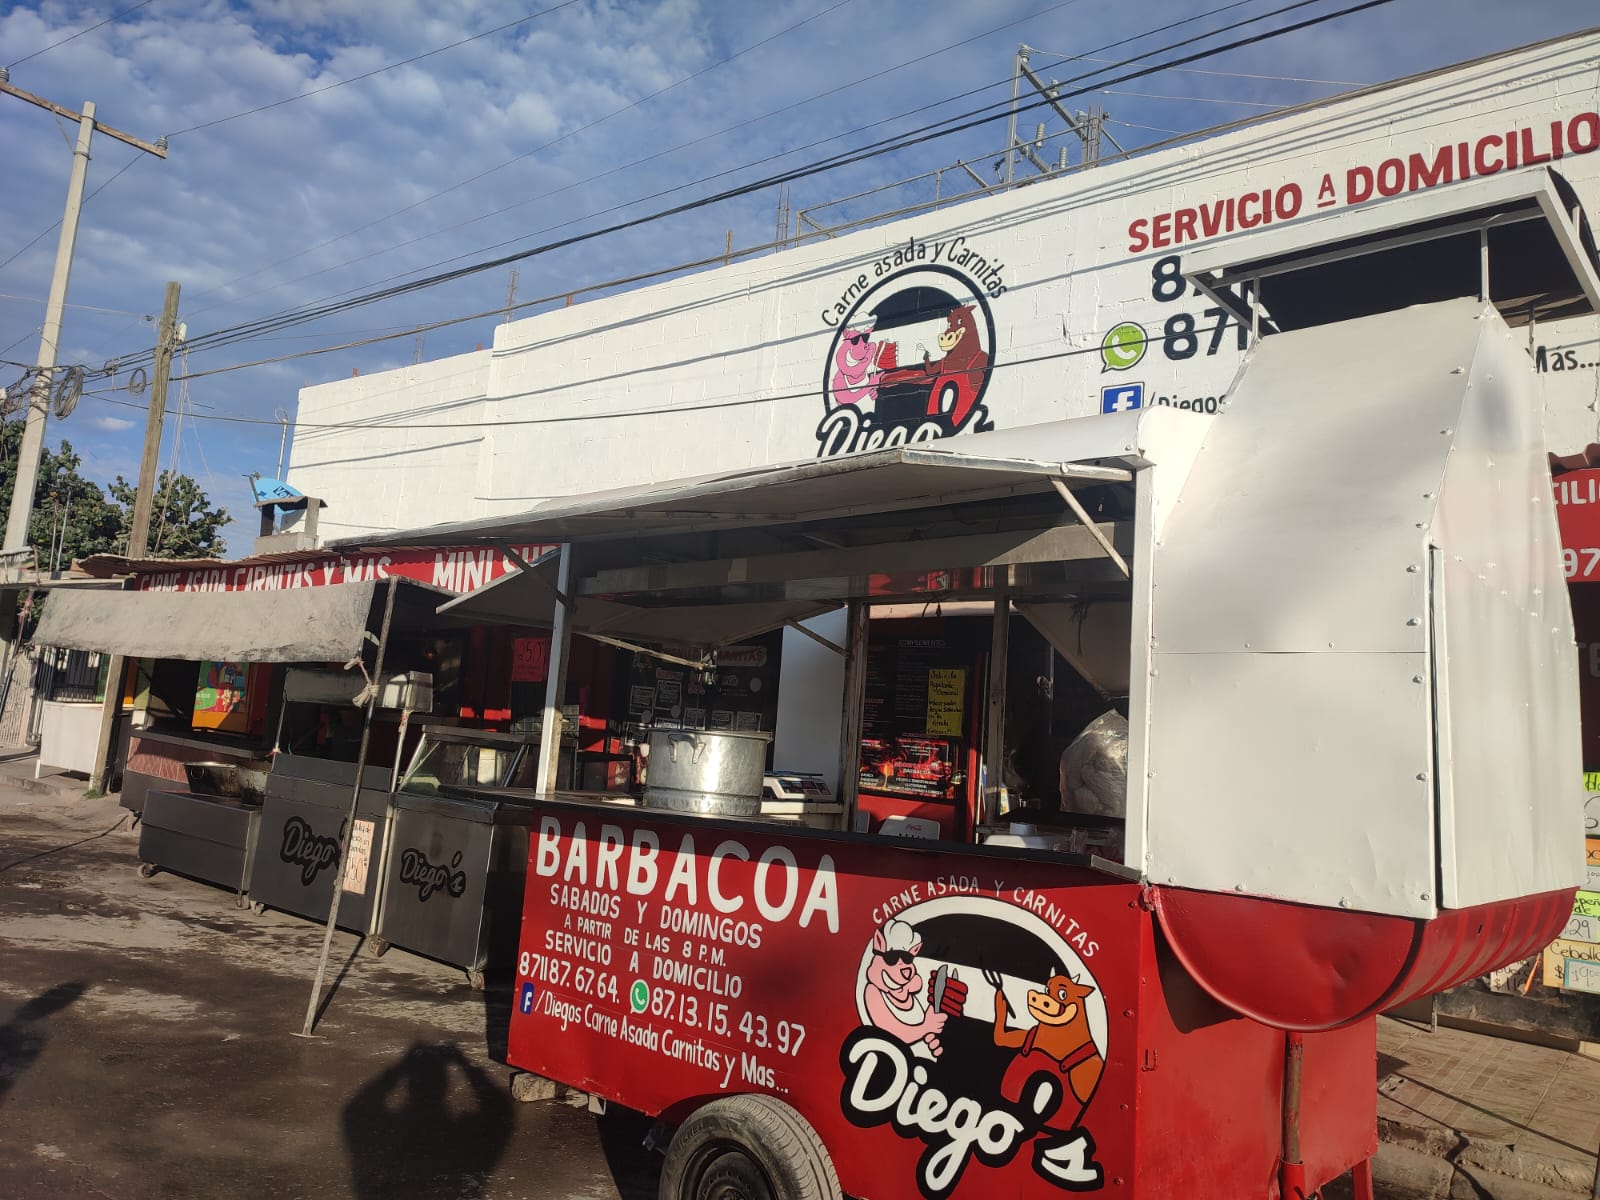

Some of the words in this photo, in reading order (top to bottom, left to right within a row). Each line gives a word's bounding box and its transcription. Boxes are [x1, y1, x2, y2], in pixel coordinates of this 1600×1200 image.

[1128, 182, 1302, 254] SERVICIO
[1317, 173, 1337, 208] A
[1347, 112, 1600, 205] DOMICILIO
[821, 272, 870, 327] Carne
[873, 236, 926, 277] asada
[930, 242, 947, 263] y
[947, 237, 1008, 299] Carnitas
[185, 569, 228, 592] ASADA
[233, 562, 317, 592] CARNITAS
[323, 561, 336, 586] Y
[343, 556, 392, 583] MAS
[432, 549, 494, 593] MINI
[401, 850, 466, 900] Diego's
[536, 816, 840, 934] BARBACOA
[550, 883, 621, 920] SABADOS
[637, 900, 648, 924] Y
[660, 905, 763, 949] DOMINGOS
[564, 913, 572, 930] A
[577, 914, 612, 940] PARTIR
[624, 927, 639, 946] DE
[645, 931, 671, 954] LAS
[682, 940, 692, 957] 8
[699, 943, 727, 967] P.M.
[873, 885, 921, 925] CARNE
[927, 875, 979, 897] ASADA
[994, 881, 1004, 897] Y
[1013, 887, 1100, 957] CARNITAS
[1565, 918, 1591, 939] 29
[545, 930, 612, 966] SERVICIO
[629, 951, 639, 974] A
[653, 956, 743, 999] DOMICILIO
[585, 1004, 618, 1038] Carne
[620, 1015, 658, 1051] Asada
[661, 1033, 720, 1072] Carnitas
[719, 1055, 735, 1089] y
[741, 1052, 789, 1094] Mas...
[847, 1036, 1099, 1192] Diego's
